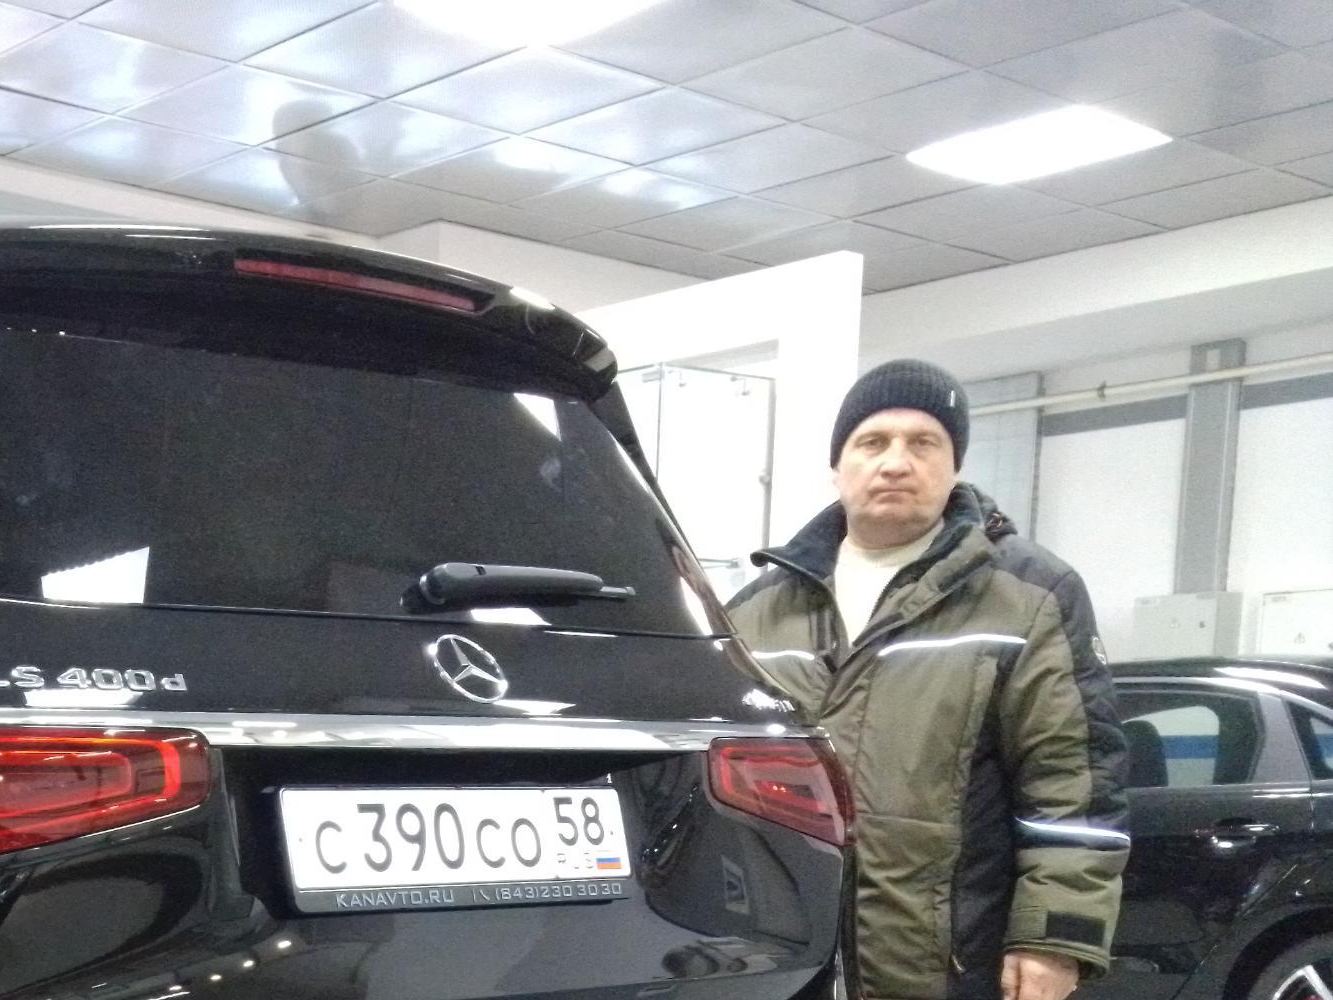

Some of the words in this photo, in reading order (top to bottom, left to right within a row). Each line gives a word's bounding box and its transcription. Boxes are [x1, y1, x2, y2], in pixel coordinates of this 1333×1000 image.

[56, 668, 188, 691] 400d
[553, 796, 605, 846] 58
[335, 889, 455, 908] KANAVTO.RU
